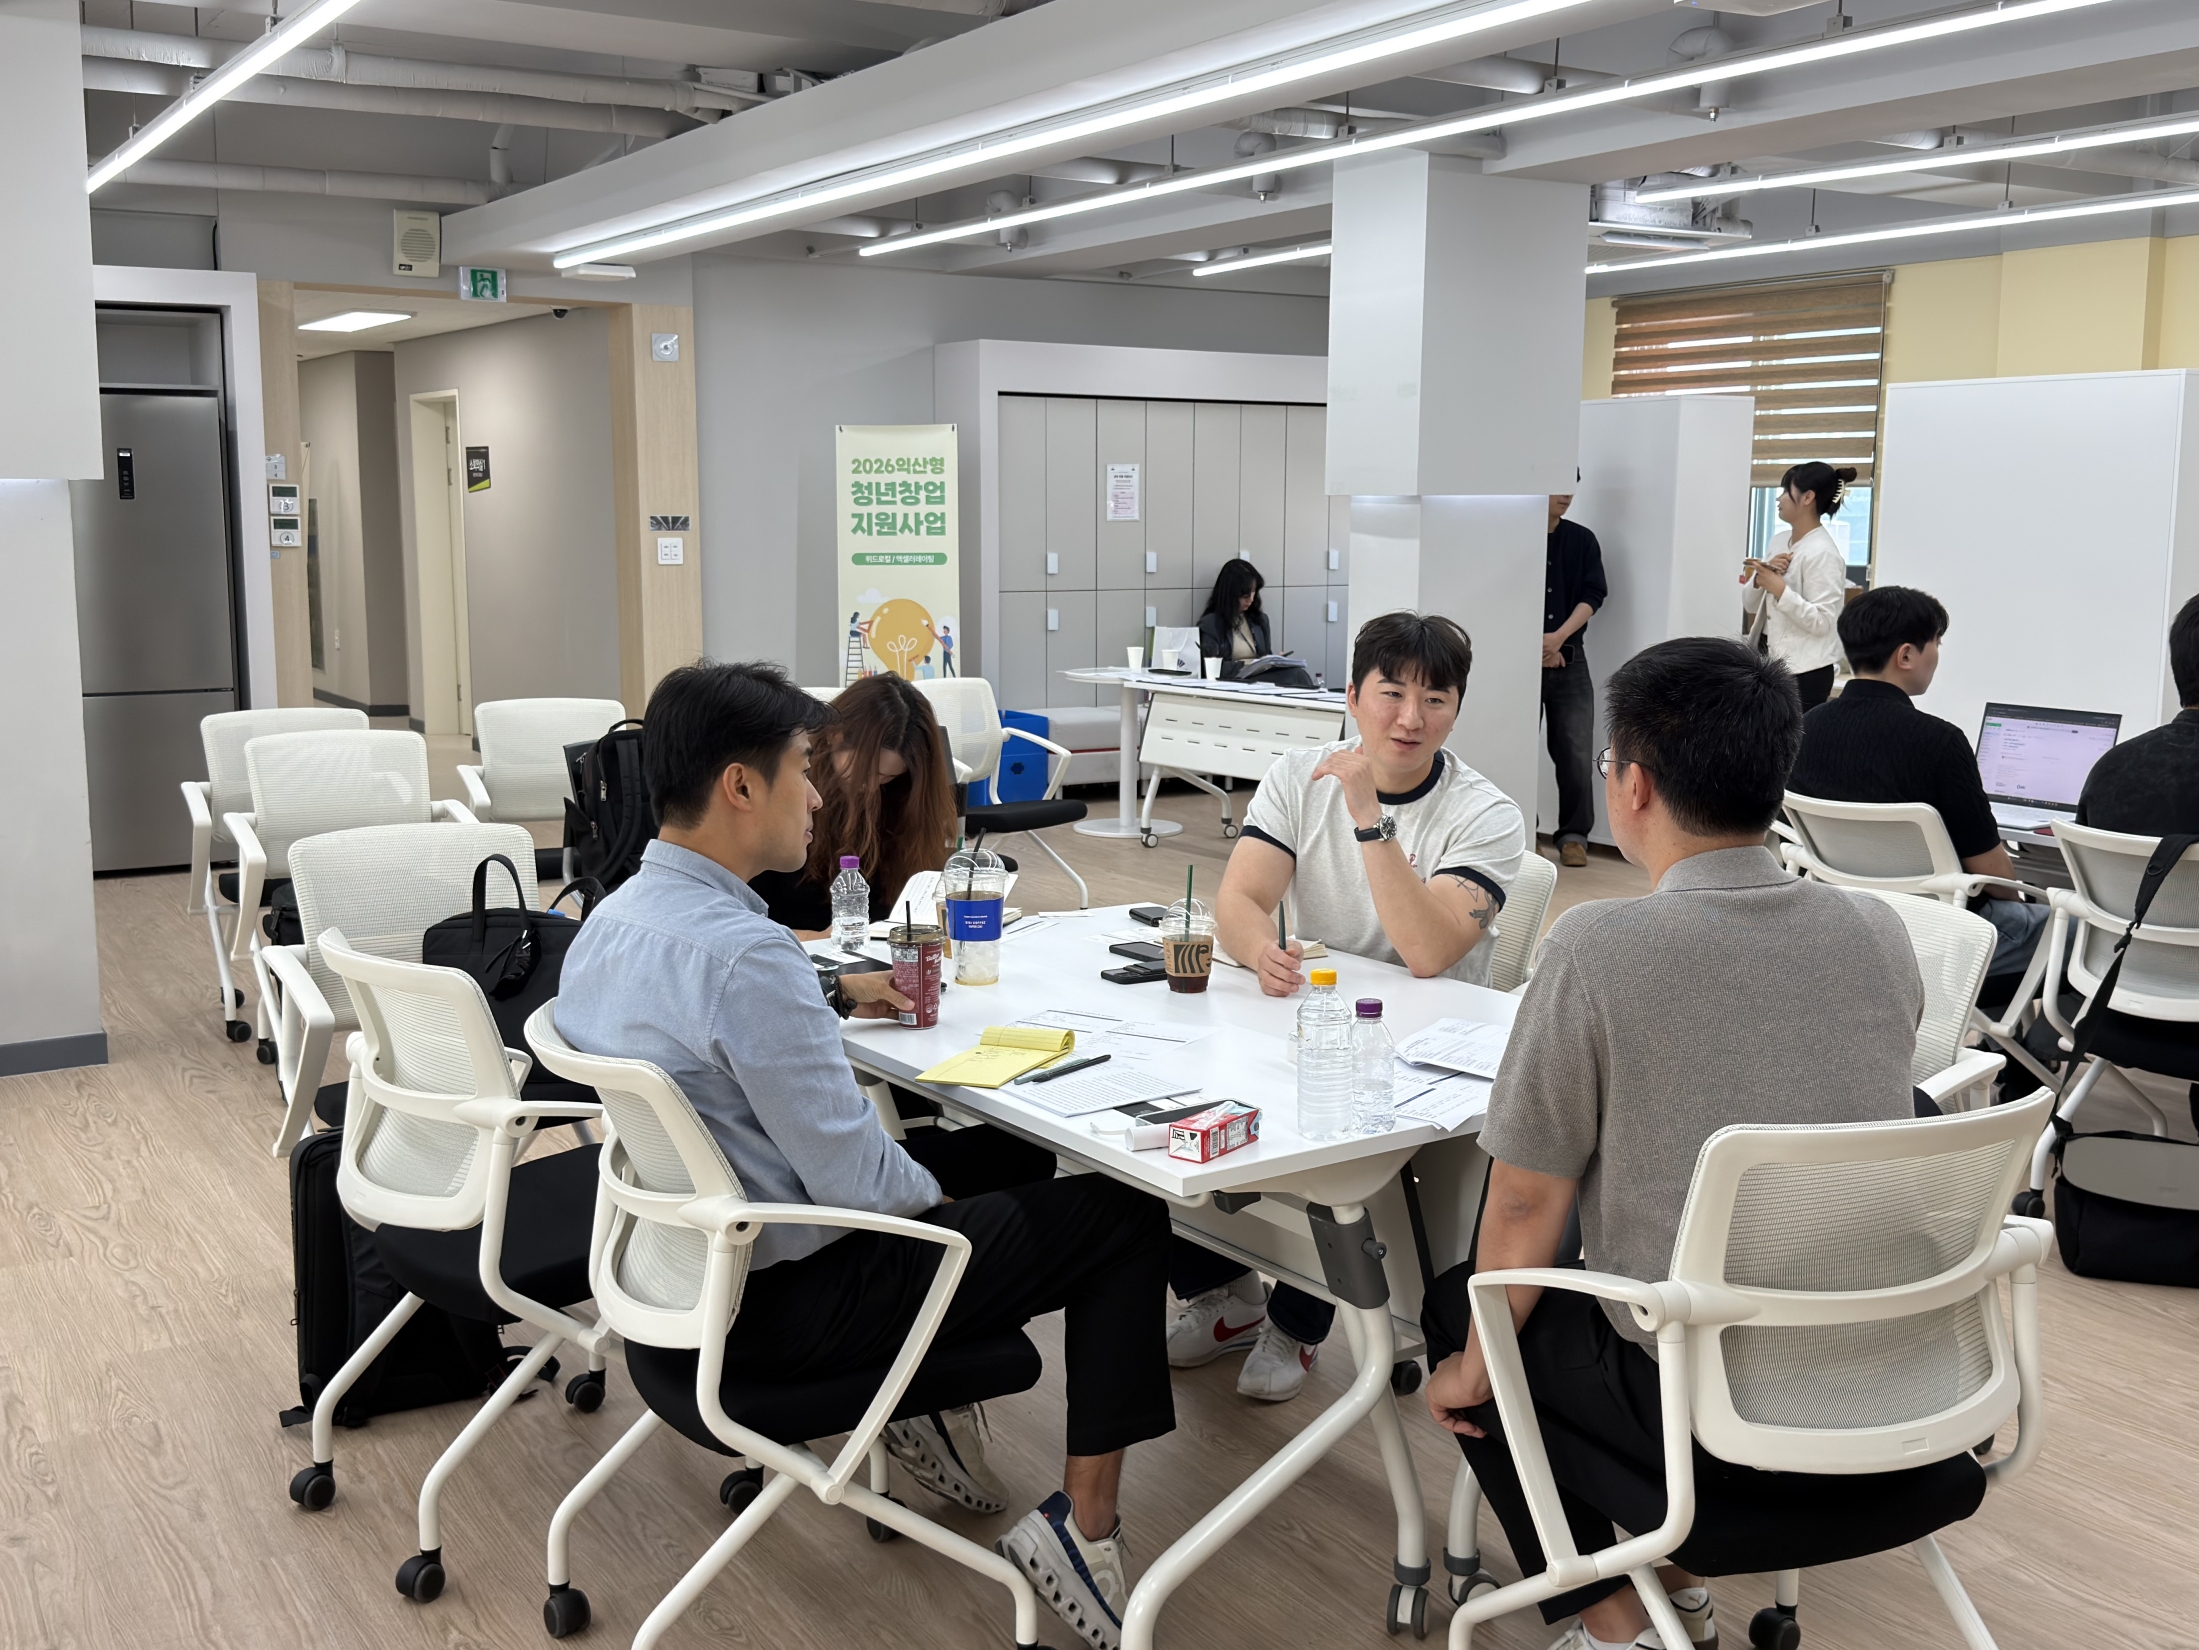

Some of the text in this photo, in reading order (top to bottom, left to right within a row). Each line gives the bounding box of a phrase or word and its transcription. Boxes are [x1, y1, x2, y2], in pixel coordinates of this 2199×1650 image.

[851, 457, 945, 475] 2026익산형
[850, 480, 946, 506] 청년창업
[850, 512, 946, 536] 지원사업
